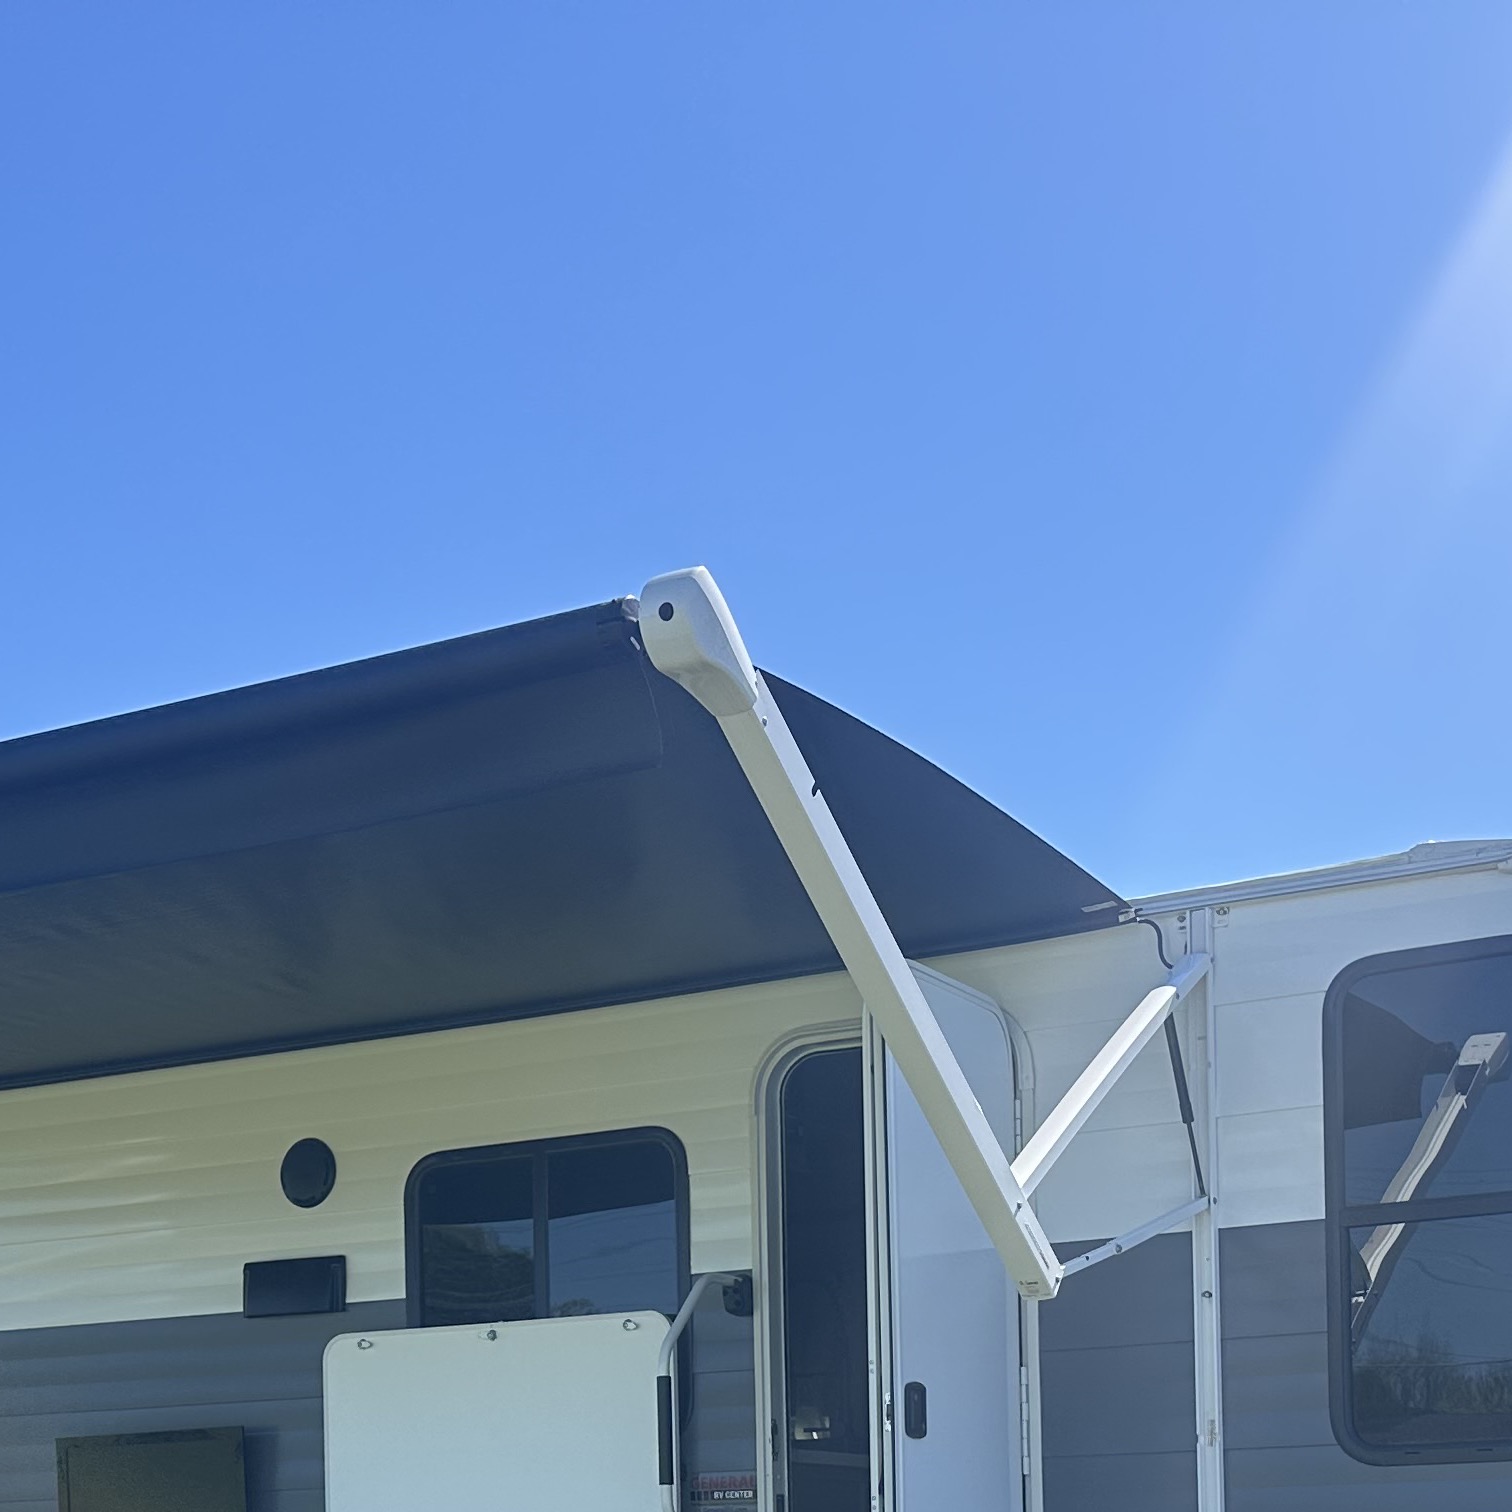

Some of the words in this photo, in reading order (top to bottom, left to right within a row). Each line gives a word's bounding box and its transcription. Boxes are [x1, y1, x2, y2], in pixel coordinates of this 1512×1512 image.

[692, 1476, 755, 1489] GENERAL
[713, 1491, 724, 1499] RV
[725, 1490, 753, 1499] CENTER
